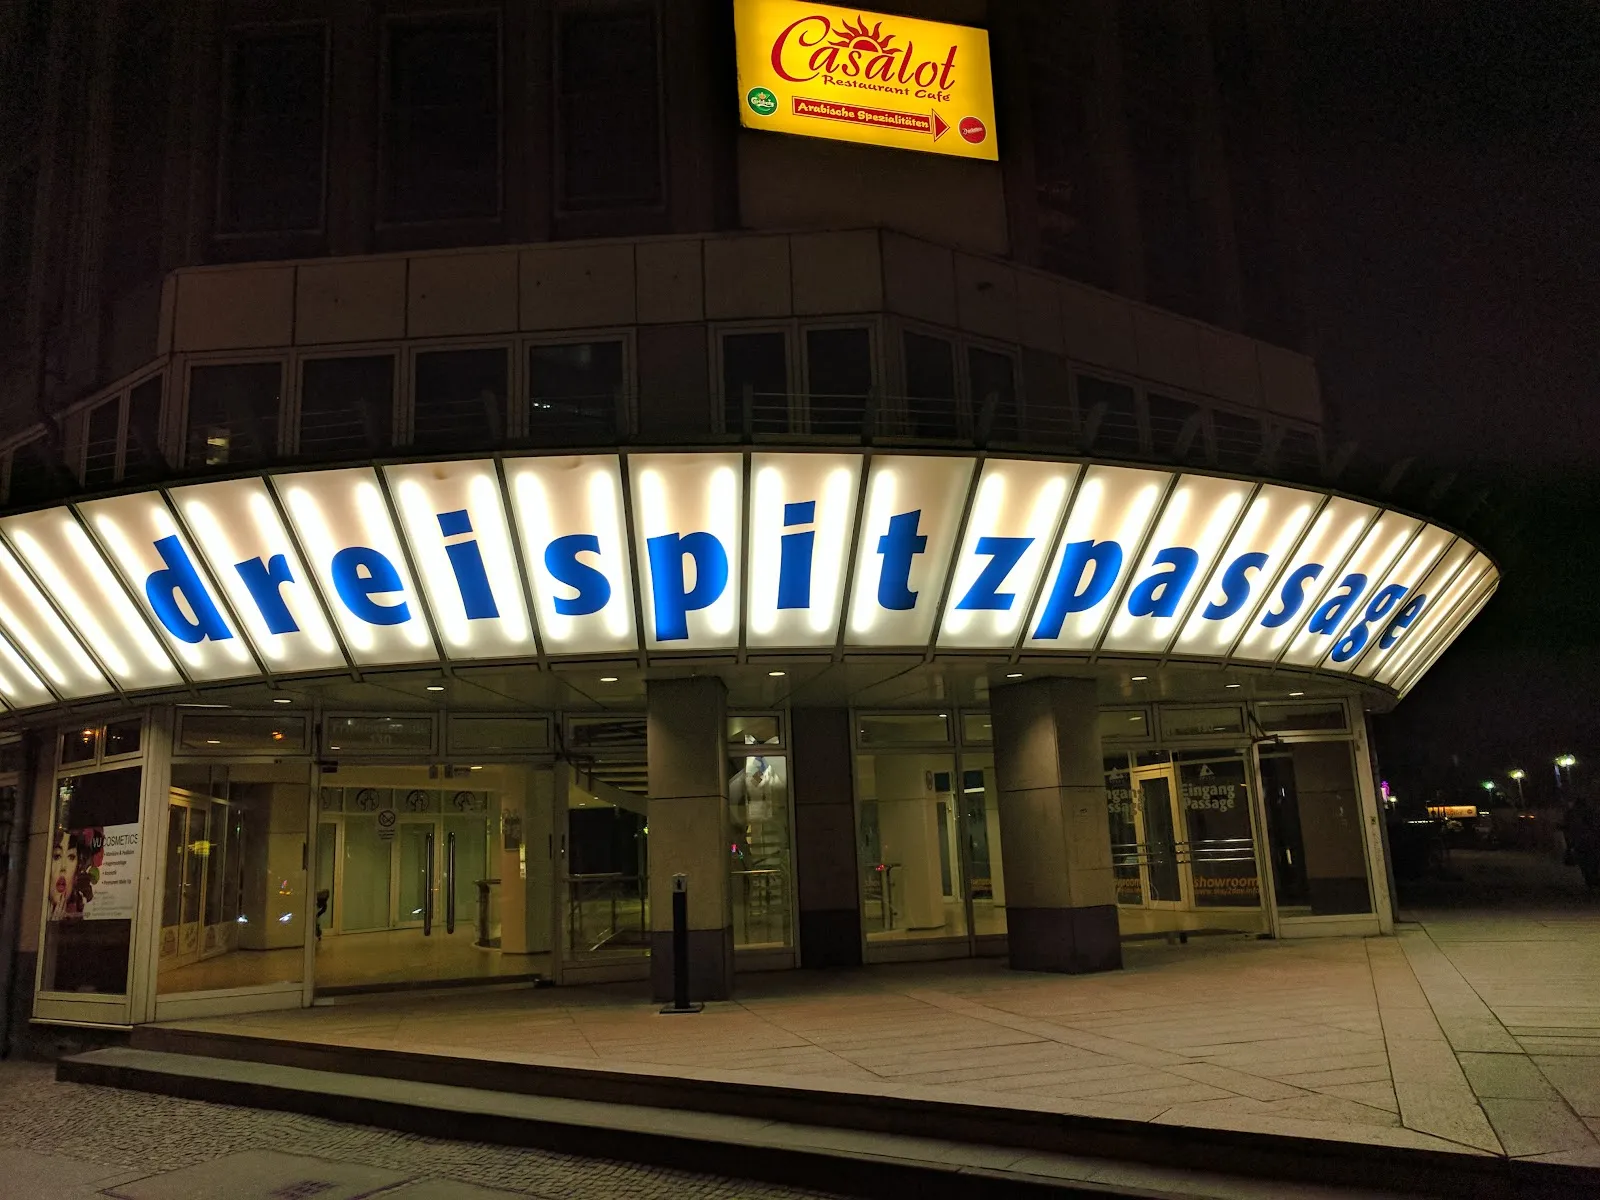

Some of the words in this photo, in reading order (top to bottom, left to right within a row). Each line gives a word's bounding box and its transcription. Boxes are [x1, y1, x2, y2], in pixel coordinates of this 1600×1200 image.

[770, 15, 958, 91] Casalot
[822, 74, 910, 96] Restaurant
[914, 88, 951, 102] Café
[797, 102, 855, 119] Arabische
[856, 110, 930, 129] Spezialitäten
[145, 500, 1427, 663] dreispitzpassage
[1181, 783, 1236, 799] Eingang
[1183, 796, 1236, 812] Passage
[1193, 875, 1260, 888] showroom
